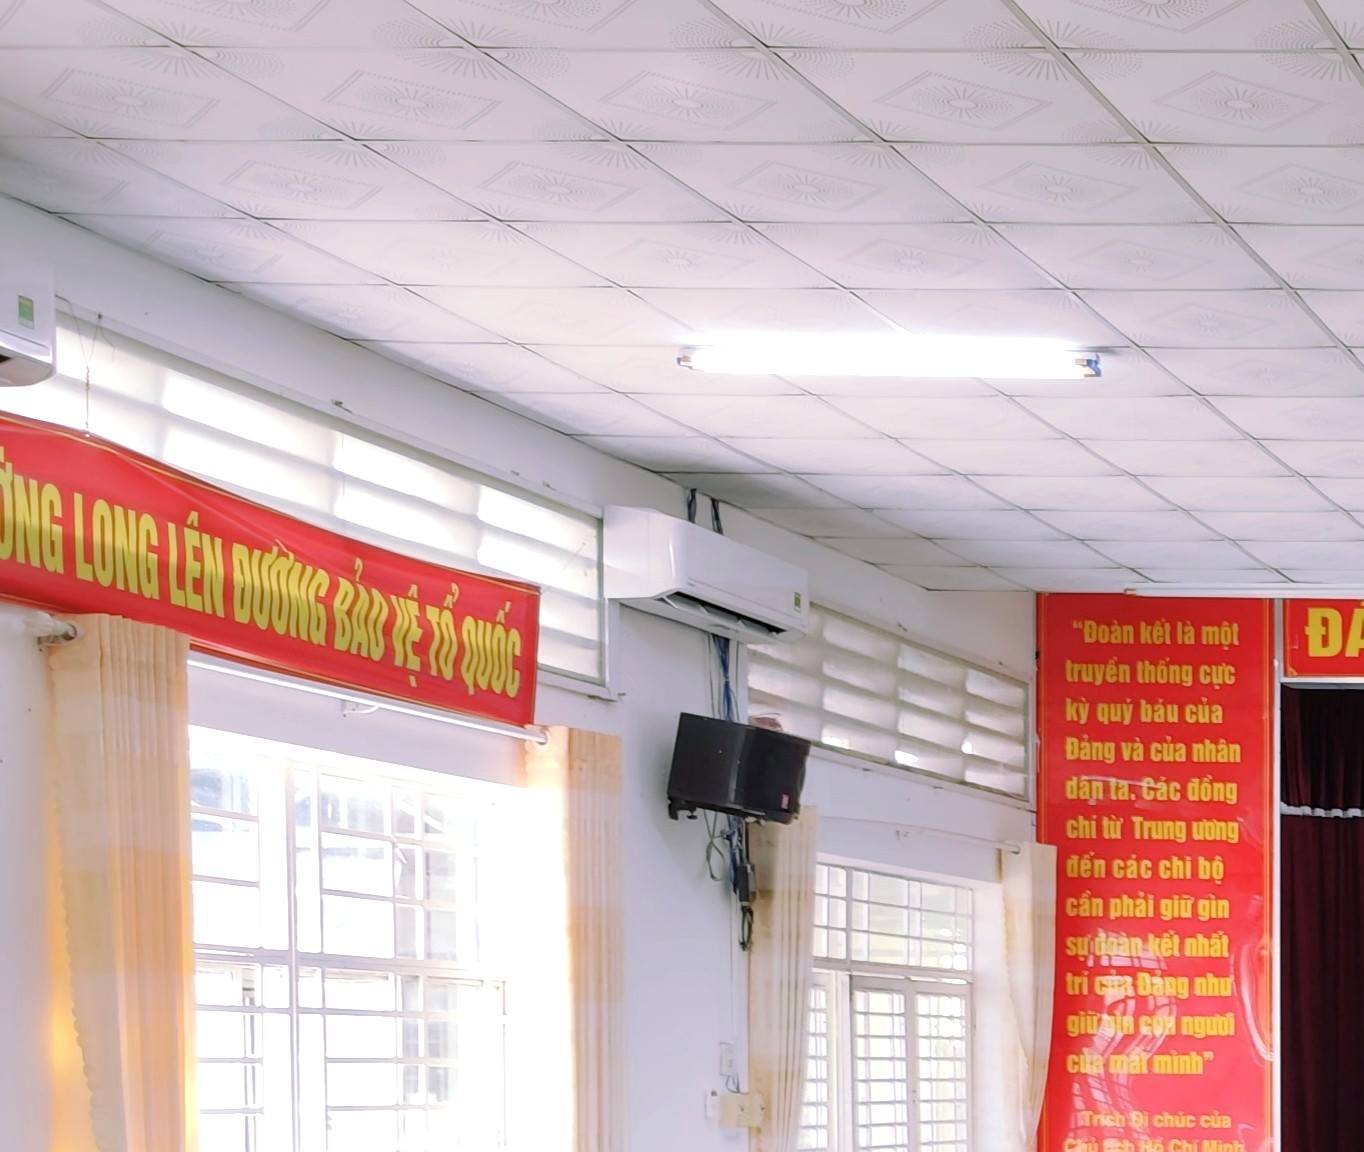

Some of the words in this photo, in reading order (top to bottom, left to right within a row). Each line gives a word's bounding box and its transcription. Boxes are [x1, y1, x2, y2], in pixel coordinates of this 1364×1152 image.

[74, 492, 159, 600] LONG
[167, 511, 226, 618] LÊN
[232, 539, 330, 646] ĐƯỜNG
[333, 557, 388, 661] BẢO
[390, 584, 423, 687] VỆ
[426, 583, 459, 681] TỔ
[460, 600, 521, 698] QUỐC
[1140, 618, 1171, 644] kết
[1177, 619, 1195, 644] là
[1202, 622, 1239, 650] một
[1137, 657, 1192, 686] thống
[1066, 734, 1115, 763] Đảng
[1122, 738, 1144, 761] và
[1151, 736, 1186, 762] của
[1192, 739, 1240, 762] nhân
